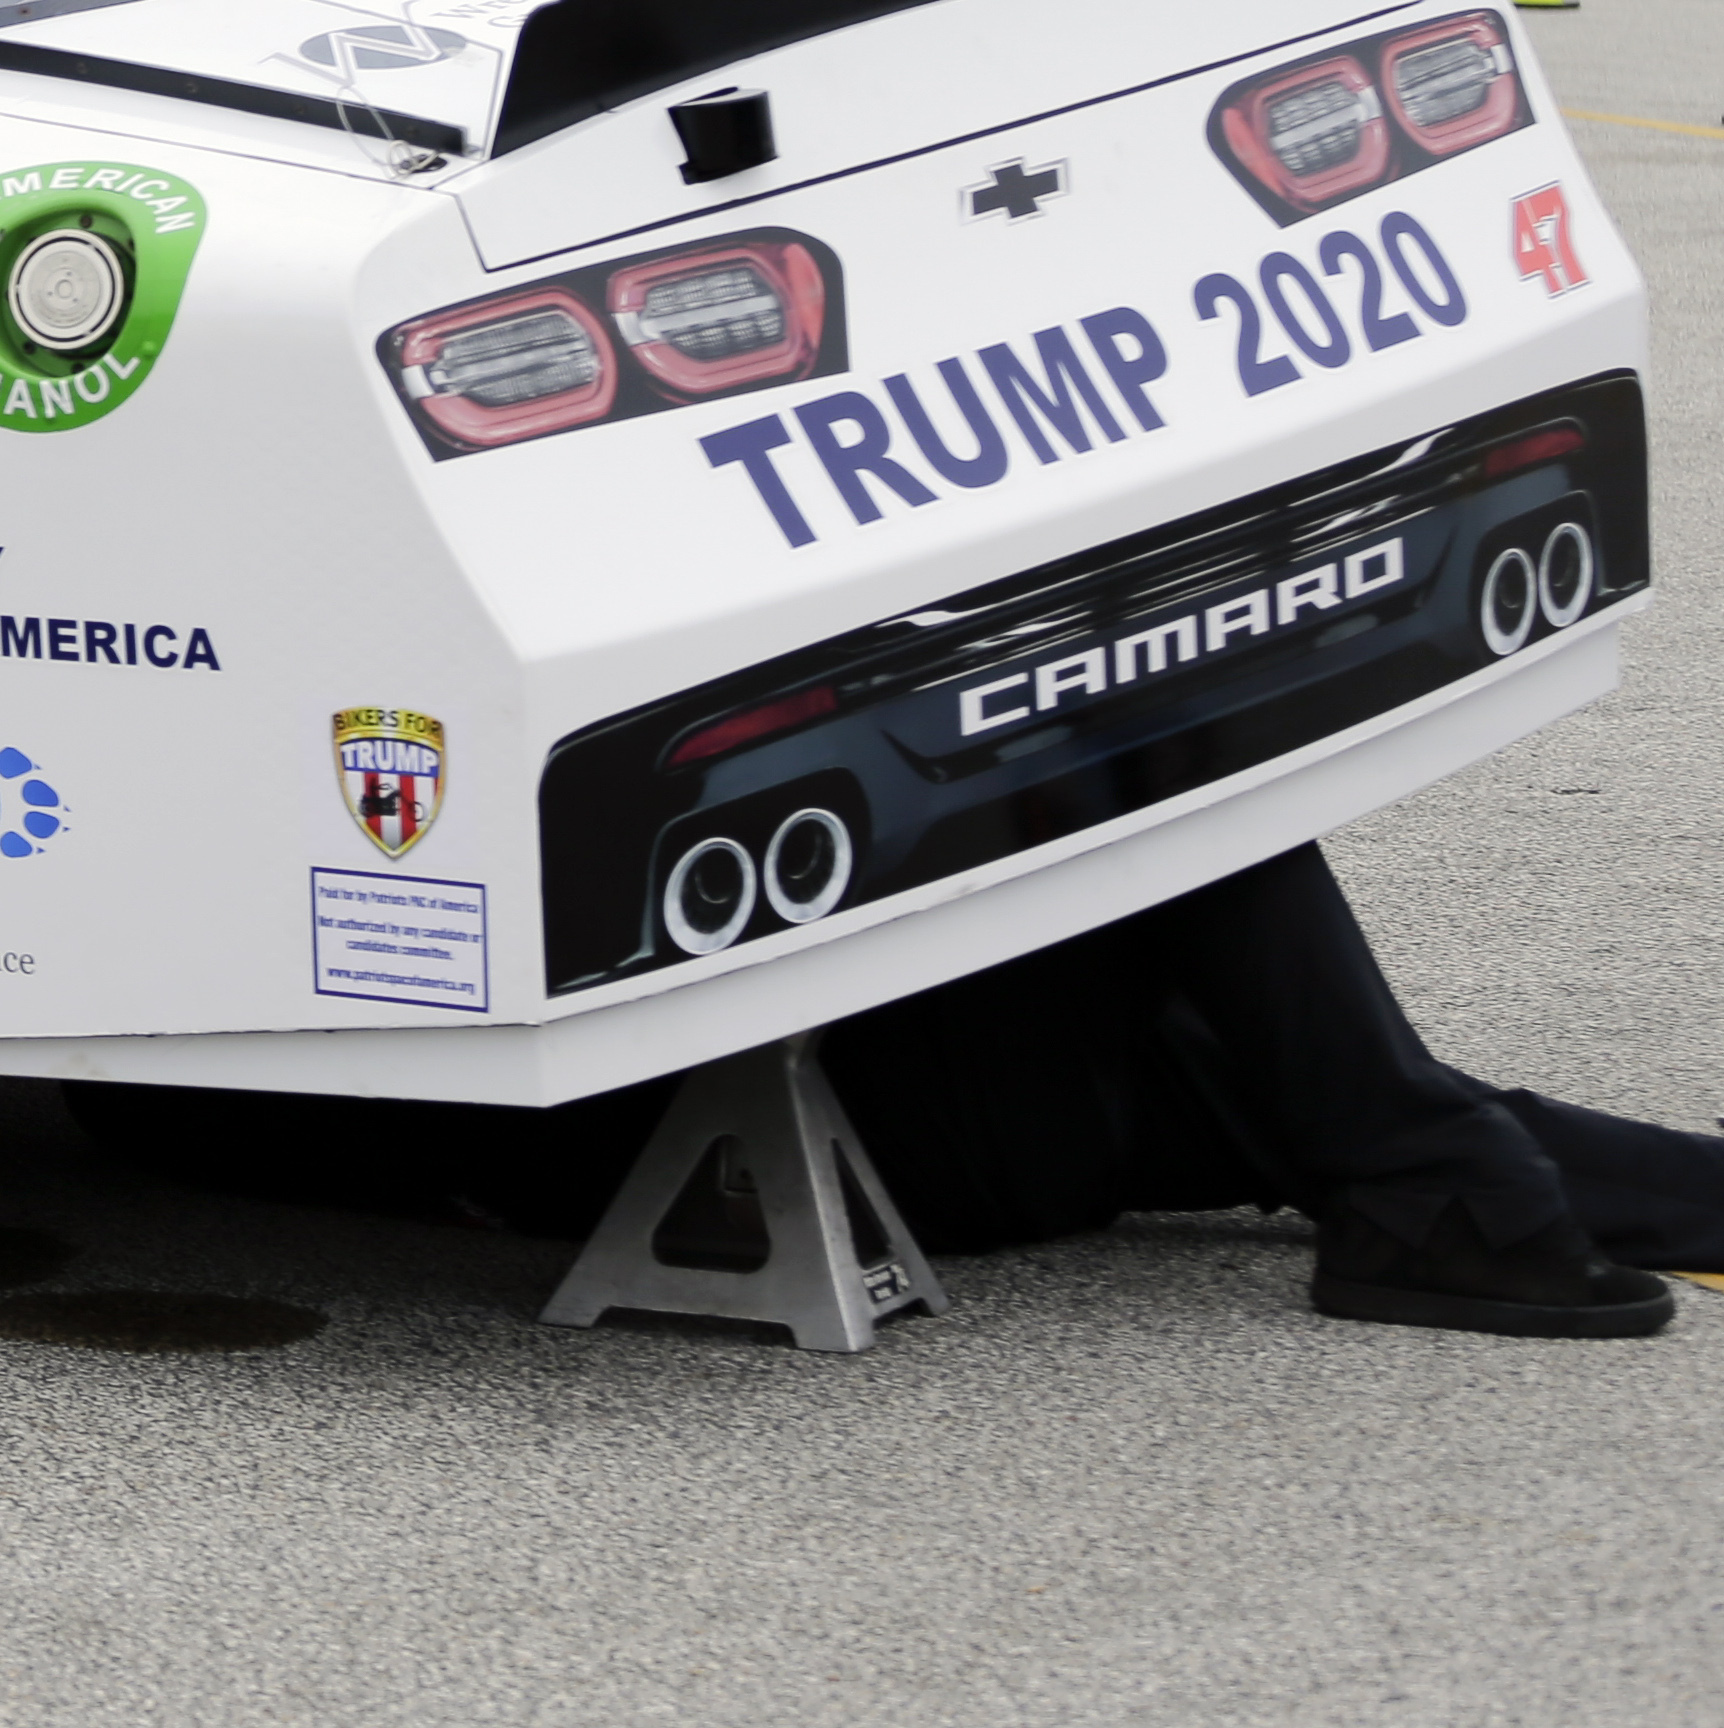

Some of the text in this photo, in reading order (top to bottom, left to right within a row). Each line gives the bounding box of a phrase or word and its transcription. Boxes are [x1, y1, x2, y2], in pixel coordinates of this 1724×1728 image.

[1508, 179, 1592, 300] 47
[697, 210, 1469, 550] TRUMP 2020
[959, 536, 1404, 737] CAMARO
[333, 709, 442, 735] BIKERS FOR
[340, 740, 440, 774] TRUMP
